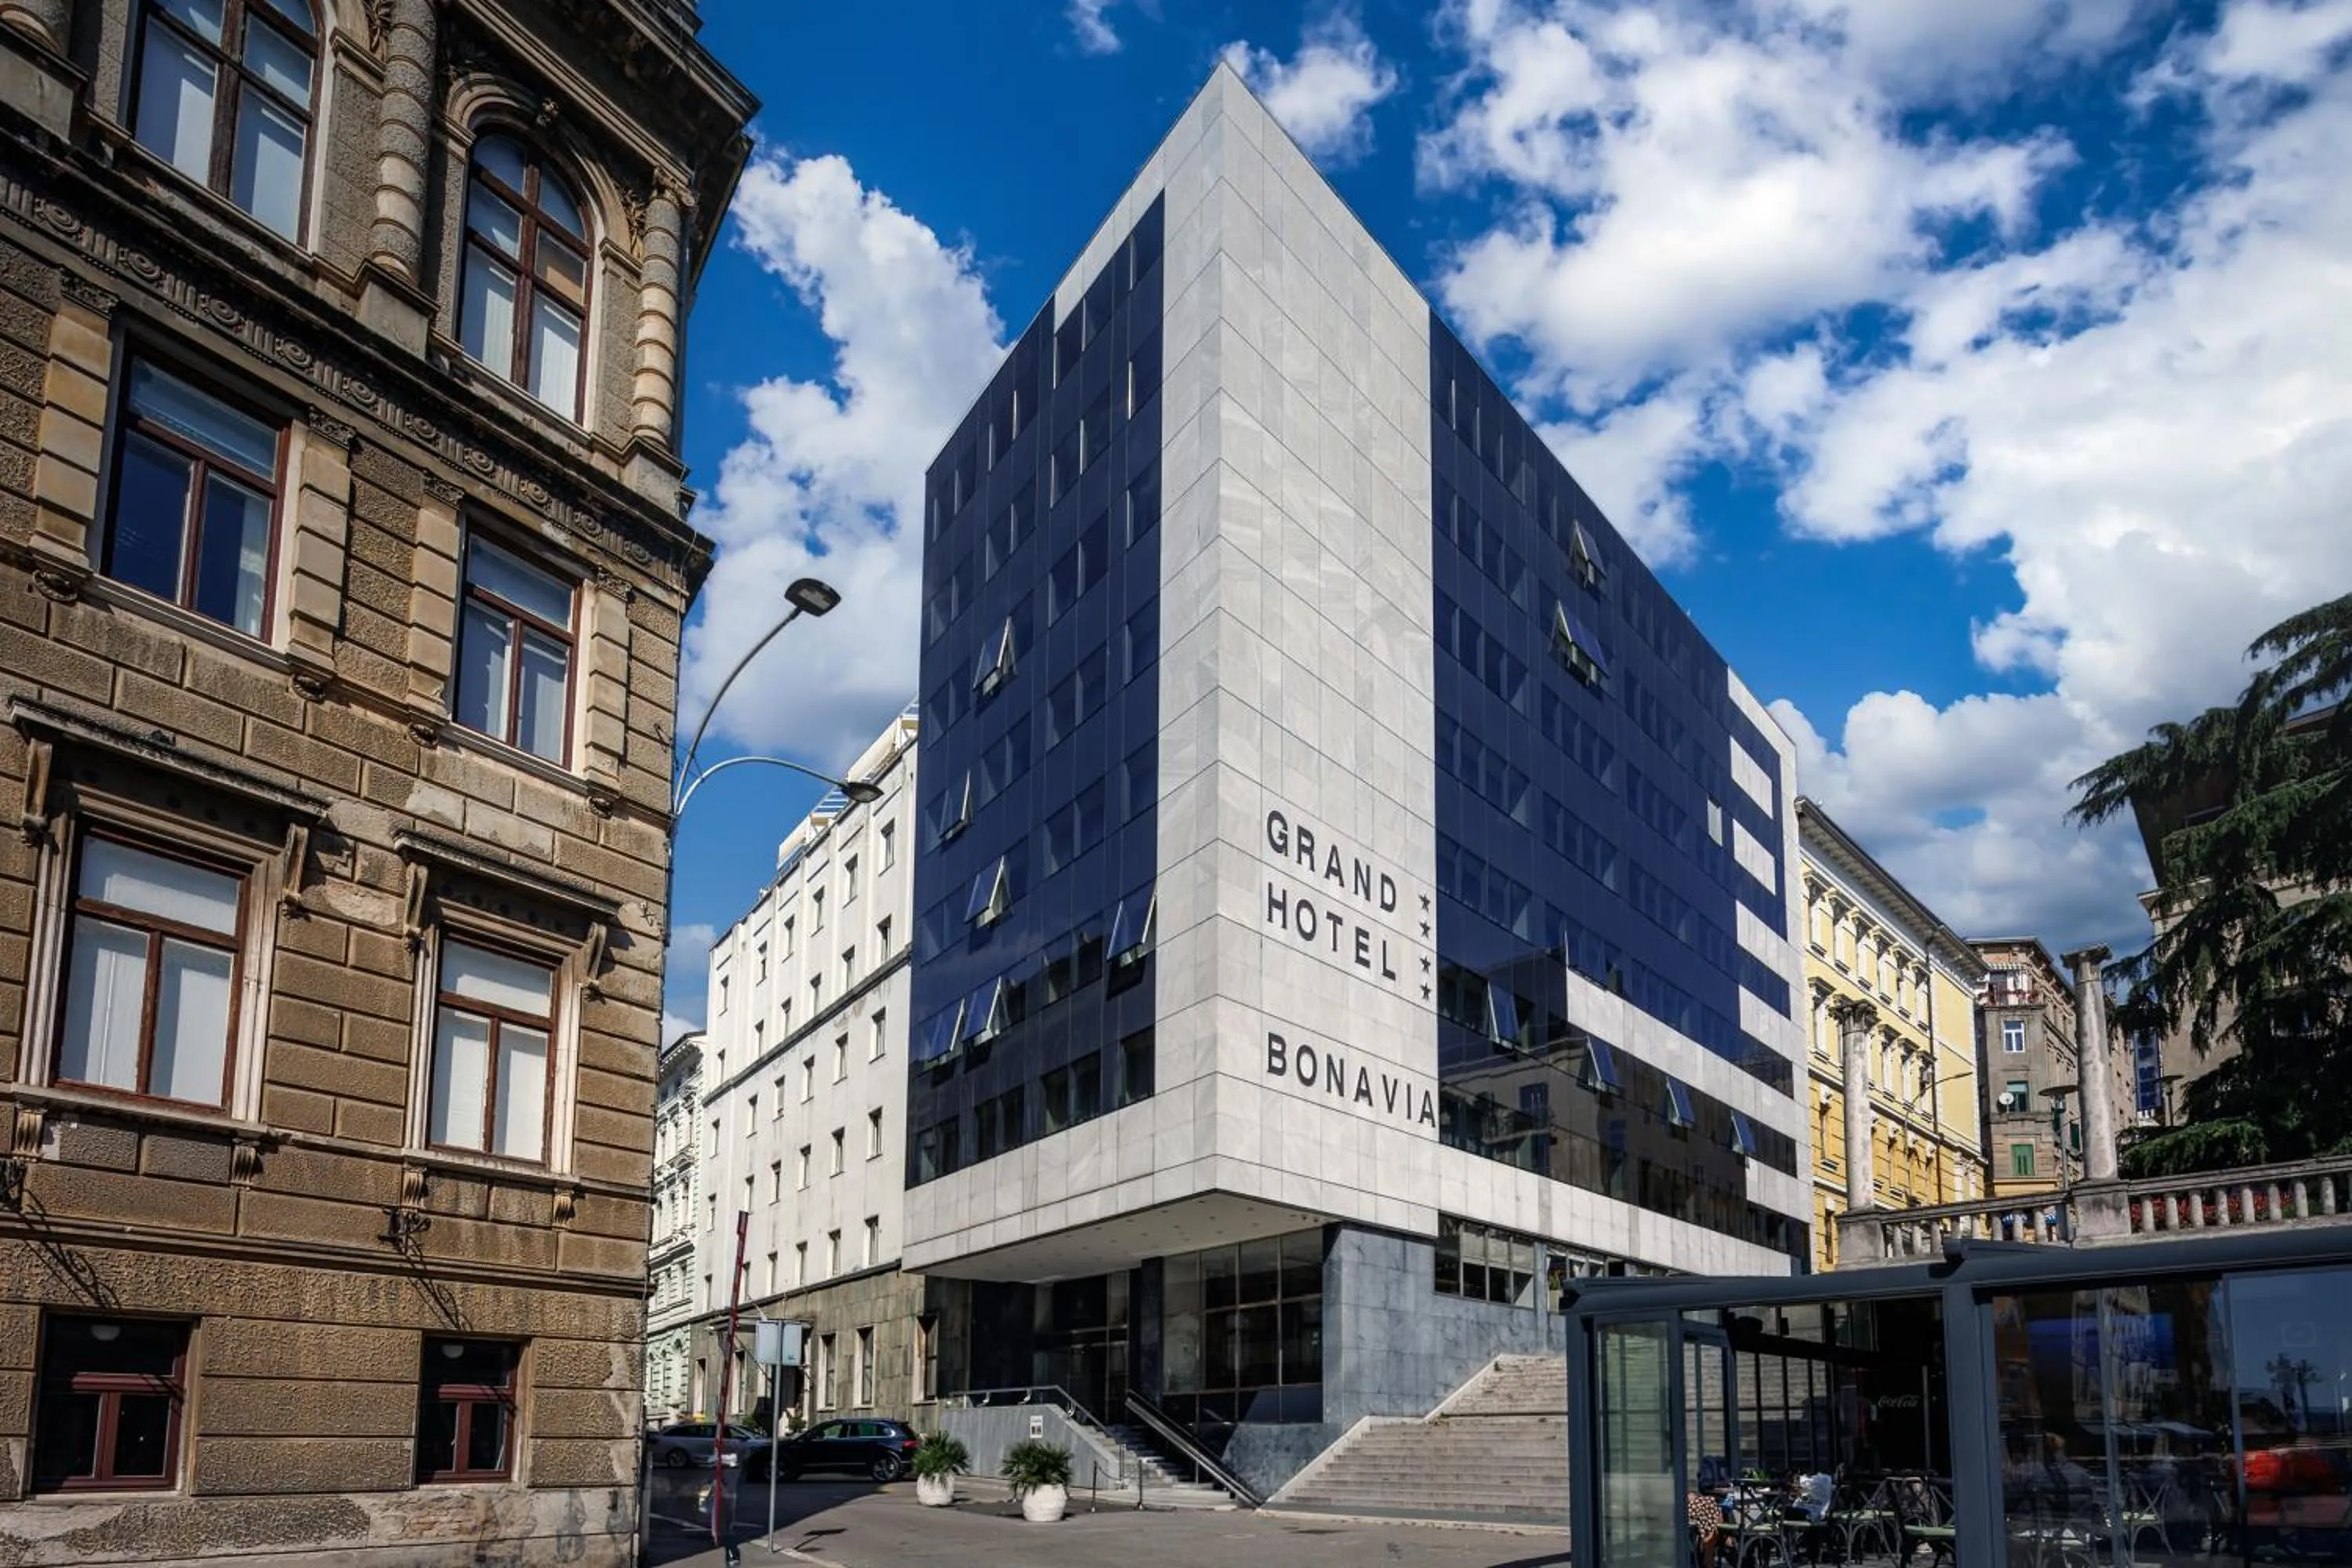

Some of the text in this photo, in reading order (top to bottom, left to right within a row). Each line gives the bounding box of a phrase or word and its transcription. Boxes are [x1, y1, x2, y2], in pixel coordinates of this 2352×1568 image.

[1266, 810, 1396, 913] GRAND
[1267, 883, 1396, 981] HOTEL
[1267, 1032, 1436, 1127] BONAVIA
